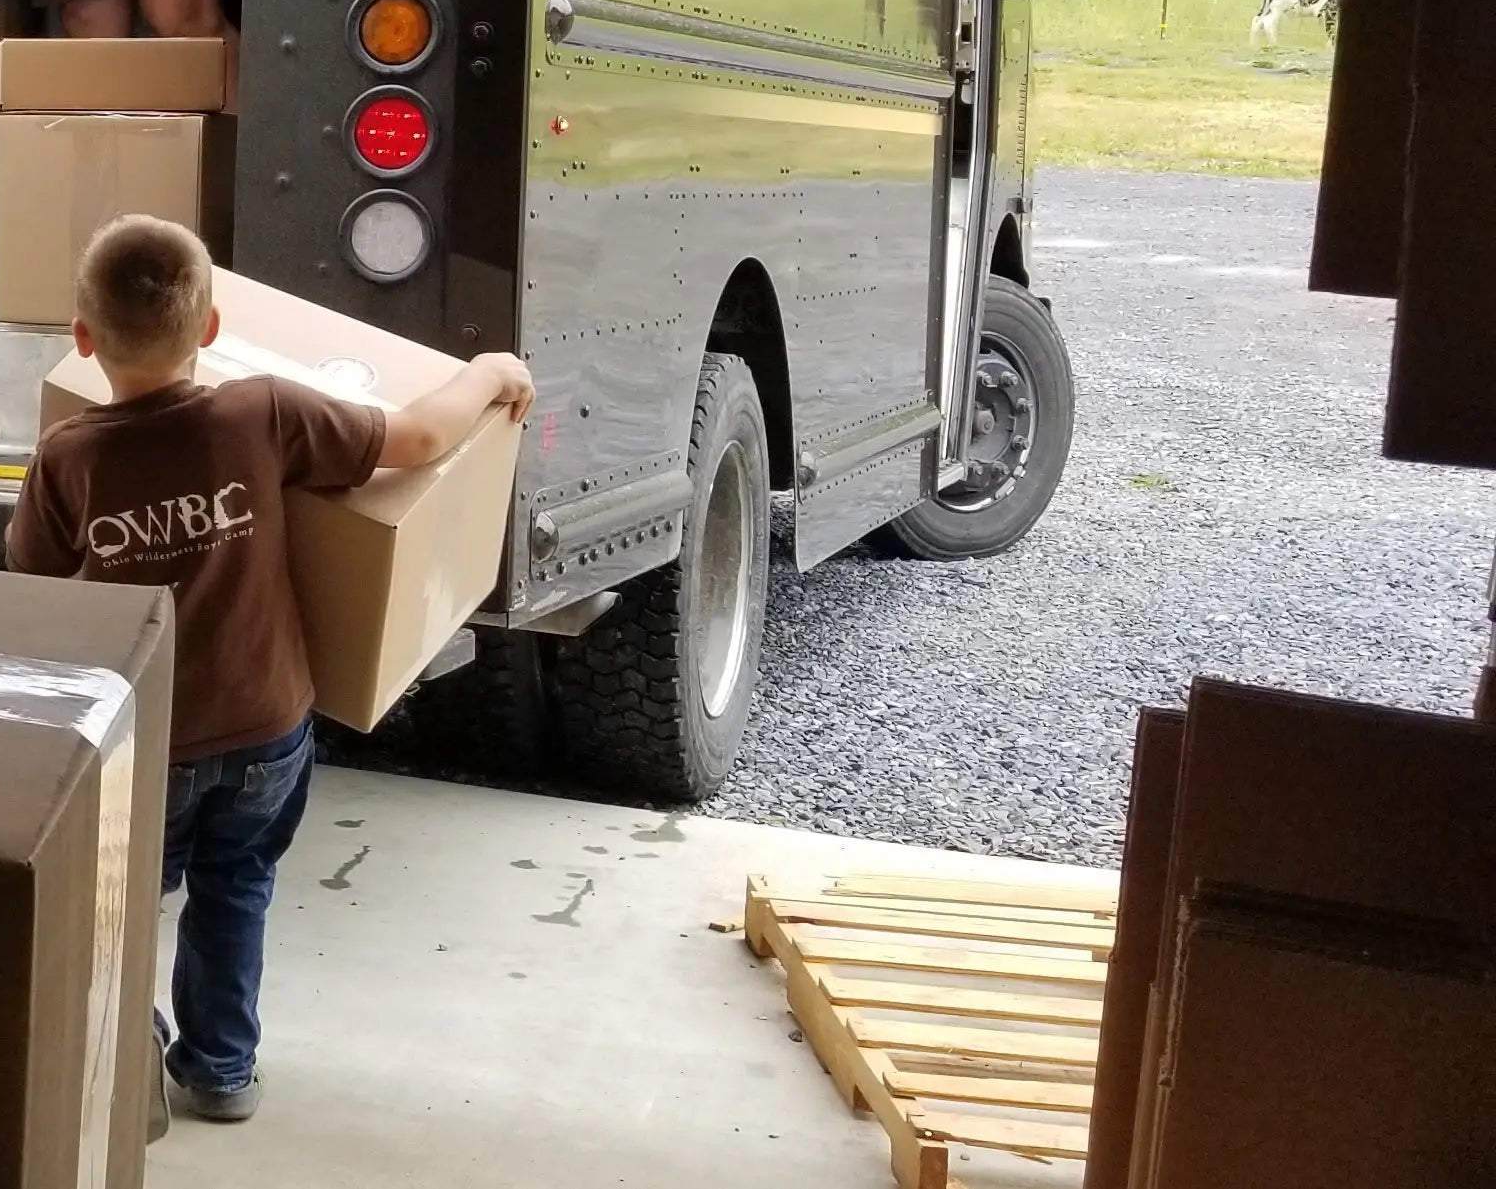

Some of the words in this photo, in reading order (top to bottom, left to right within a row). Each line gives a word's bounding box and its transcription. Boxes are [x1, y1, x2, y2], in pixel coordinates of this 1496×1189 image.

[87, 481, 253, 557] OWBC
[103, 556, 130, 568] Ohio
[134, 546, 193, 562] Wilderness
[224, 527, 254, 541] Camp
